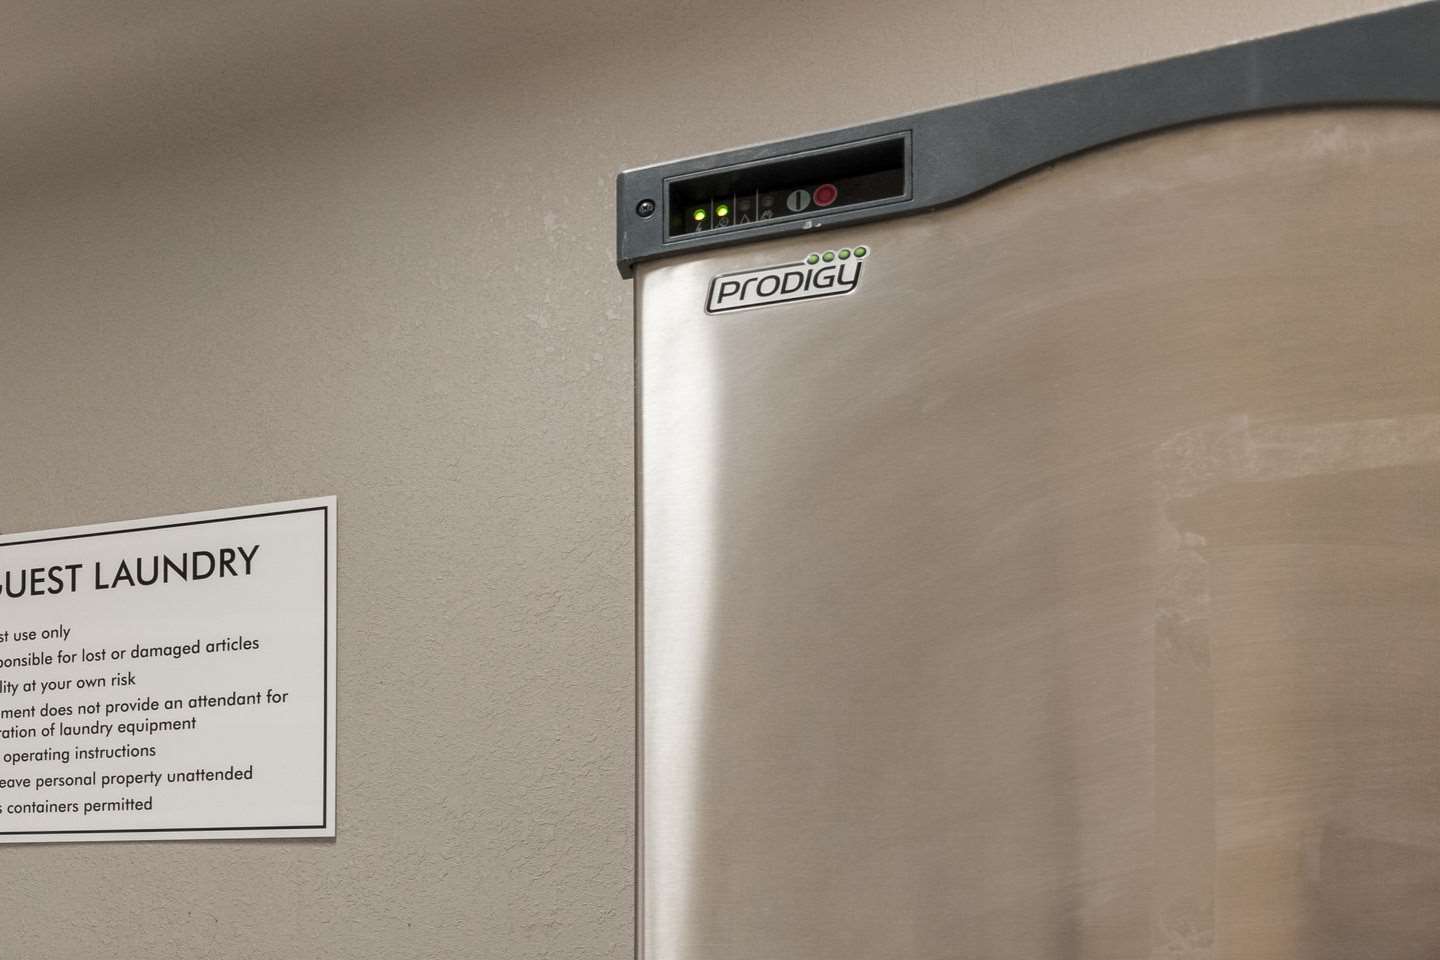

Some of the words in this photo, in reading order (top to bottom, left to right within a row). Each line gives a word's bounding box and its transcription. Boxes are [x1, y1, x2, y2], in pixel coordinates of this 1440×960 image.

[95, 545, 259, 590] LAUNDRY
[14, 631, 36, 641] use
[42, 624, 70, 641] only
[57, 650, 77, 663] for
[82, 648, 106, 662] lost
[111, 650, 126, 660] or
[131, 640, 200, 658] damaged
[206, 636, 259, 653] articles
[23, 680, 36, 692] at
[41, 680, 72, 694] your
[77, 678, 105, 688] own
[112, 672, 135, 686] risk
[40, 703, 72, 717] does
[78, 702, 100, 714] not
[106, 697, 159, 716] provide
[165, 700, 182, 709] an
[189, 692, 261, 708] attendant
[266, 689, 288, 703] for
[42, 723, 55, 736] of
[60, 720, 113, 737] laundry
[118, 717, 196, 736] equipment
[4, 748, 69, 765] operating
[75, 744, 156, 759] instructions
[36, 771, 95, 790] personal
[102, 771, 162, 788] property
[168, 765, 252, 782] unattended
[7, 800, 78, 814] containers
[84, 796, 152, 815] permitted
